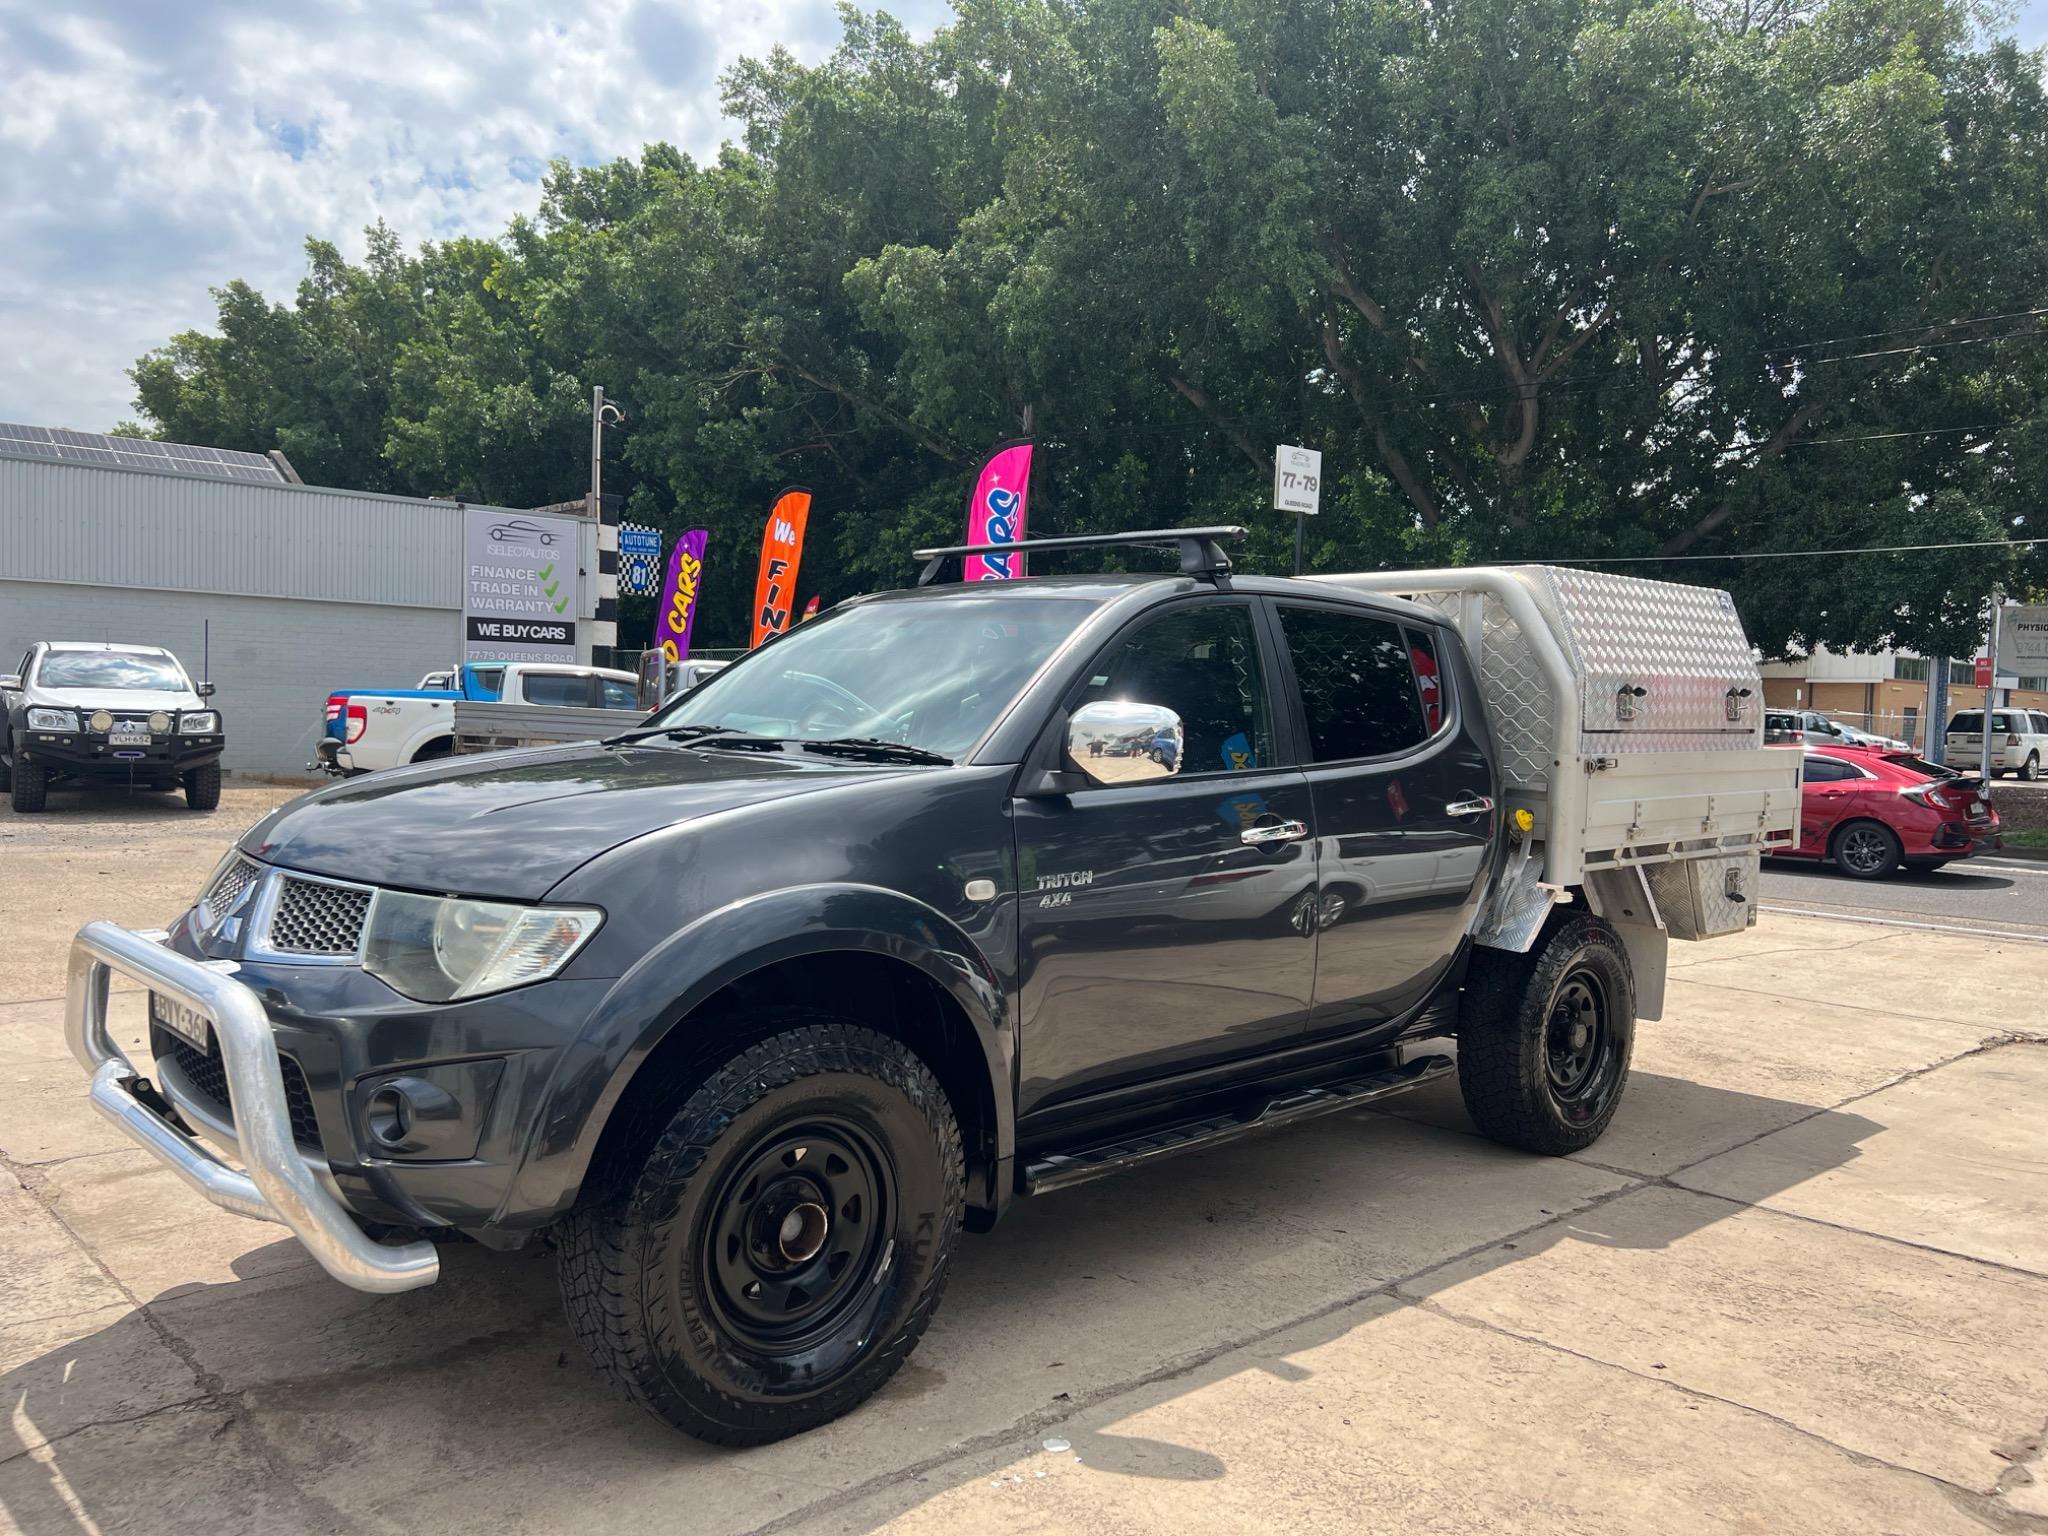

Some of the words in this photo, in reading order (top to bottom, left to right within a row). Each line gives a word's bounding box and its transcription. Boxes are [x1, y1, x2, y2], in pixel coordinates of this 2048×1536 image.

[774, 518, 795, 546] We
[981, 487, 1020, 579] ARS
[624, 534, 658, 548] AUTOTUNE
[471, 565, 536, 581] FINANCE
[631, 565, 646, 586] 81
[471, 581, 521, 596] TRADE
[524, 584, 538, 597] IN
[668, 553, 701, 633] CARS
[471, 596, 554, 613] WARRANTY
[478, 623, 500, 636] WE
[502, 624, 530, 638] BUY
[530, 625, 566, 640] CARS
[468, 650, 496, 660] 77-79
[498, 651, 544, 662] QUEENS
[544, 653, 574, 664] ROAD
[1037, 870, 1093, 890] TRITON
